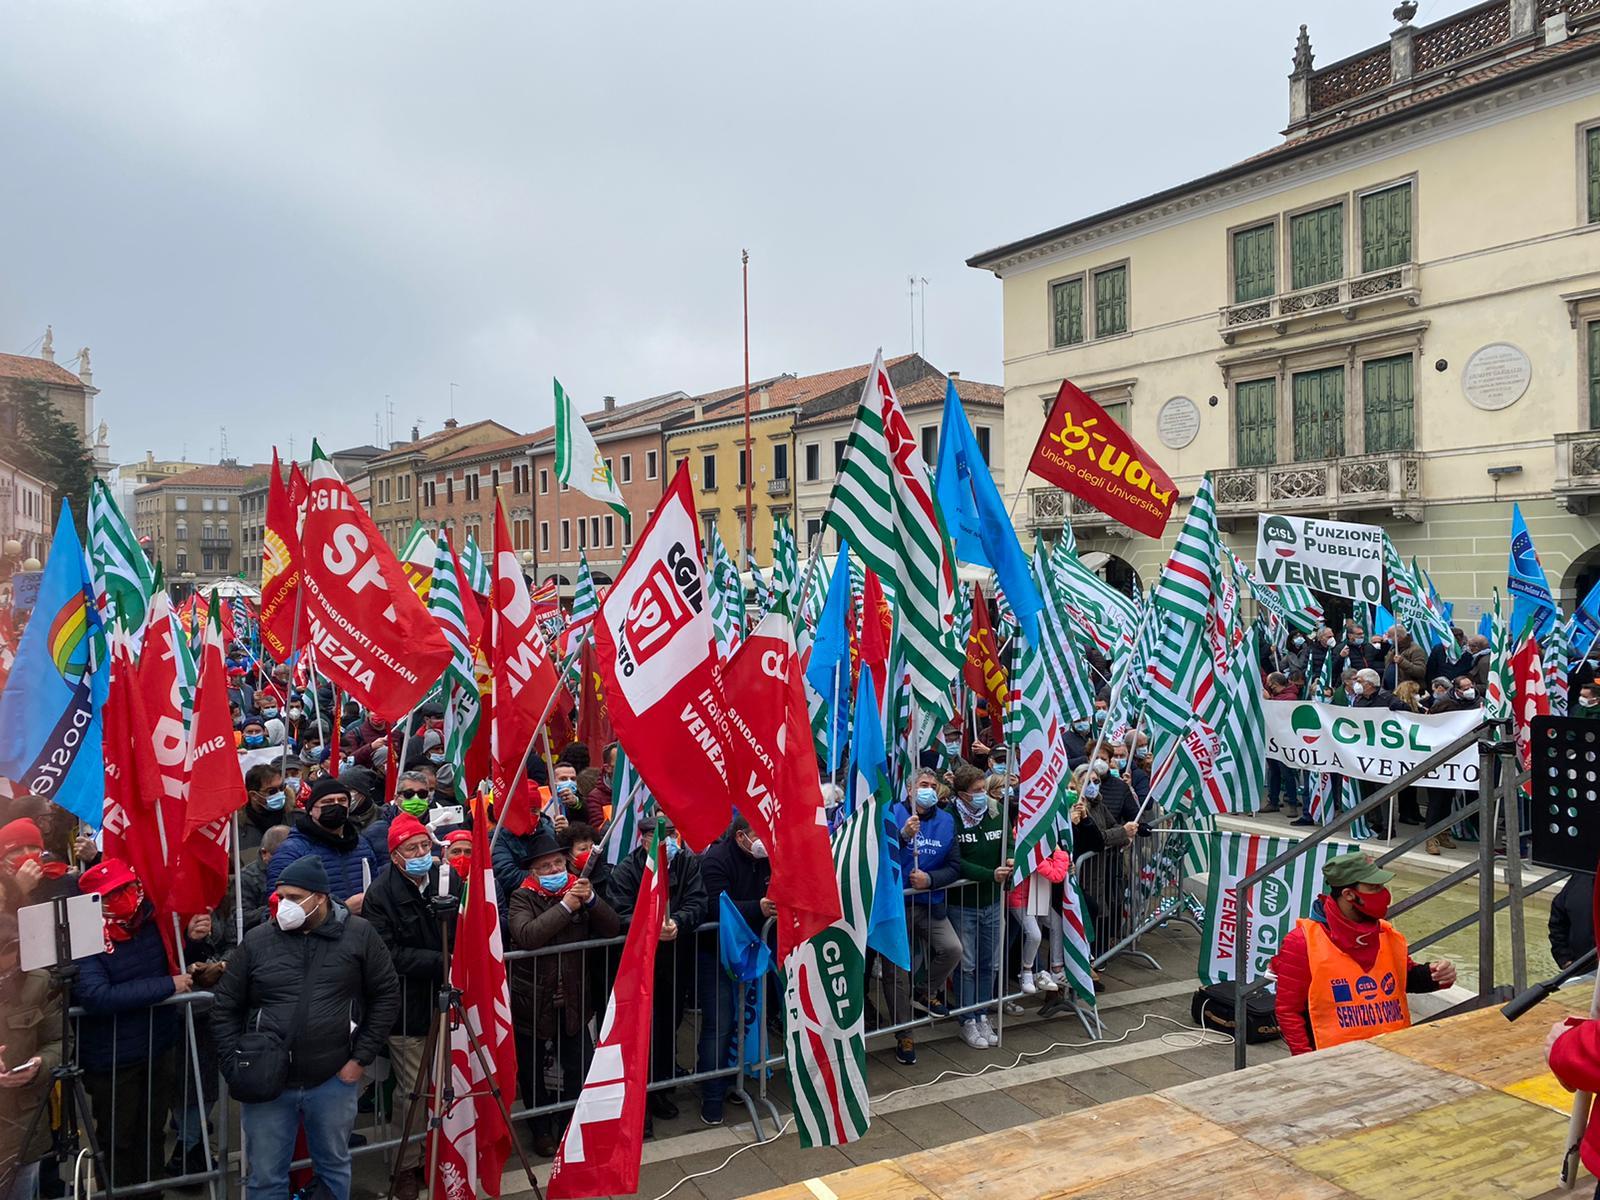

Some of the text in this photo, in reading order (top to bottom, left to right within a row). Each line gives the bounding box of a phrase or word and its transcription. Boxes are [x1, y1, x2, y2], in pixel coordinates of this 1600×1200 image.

[1041, 446, 1076, 473] Unione
[1077, 468, 1105, 488] degli
[1267, 526, 1294, 541] CISL
[1303, 520, 1381, 543] FUNZIONE
[1304, 536, 1381, 561] PUBBLICA
[667, 541, 703, 614] CGIL
[1257, 558, 1381, 602] VENETO
[317, 592, 372, 648] PENSIONATI
[371, 643, 418, 684] ITALIANI
[727, 707, 776, 776] SINDACAT
[1331, 716, 1432, 753] CISL
[1264, 880, 1279, 913] FNP
[1217, 887, 1238, 959] VENEZIA
[822, 940, 850, 1019] CISL
[1336, 1003, 1377, 1029] SERVIZIO
